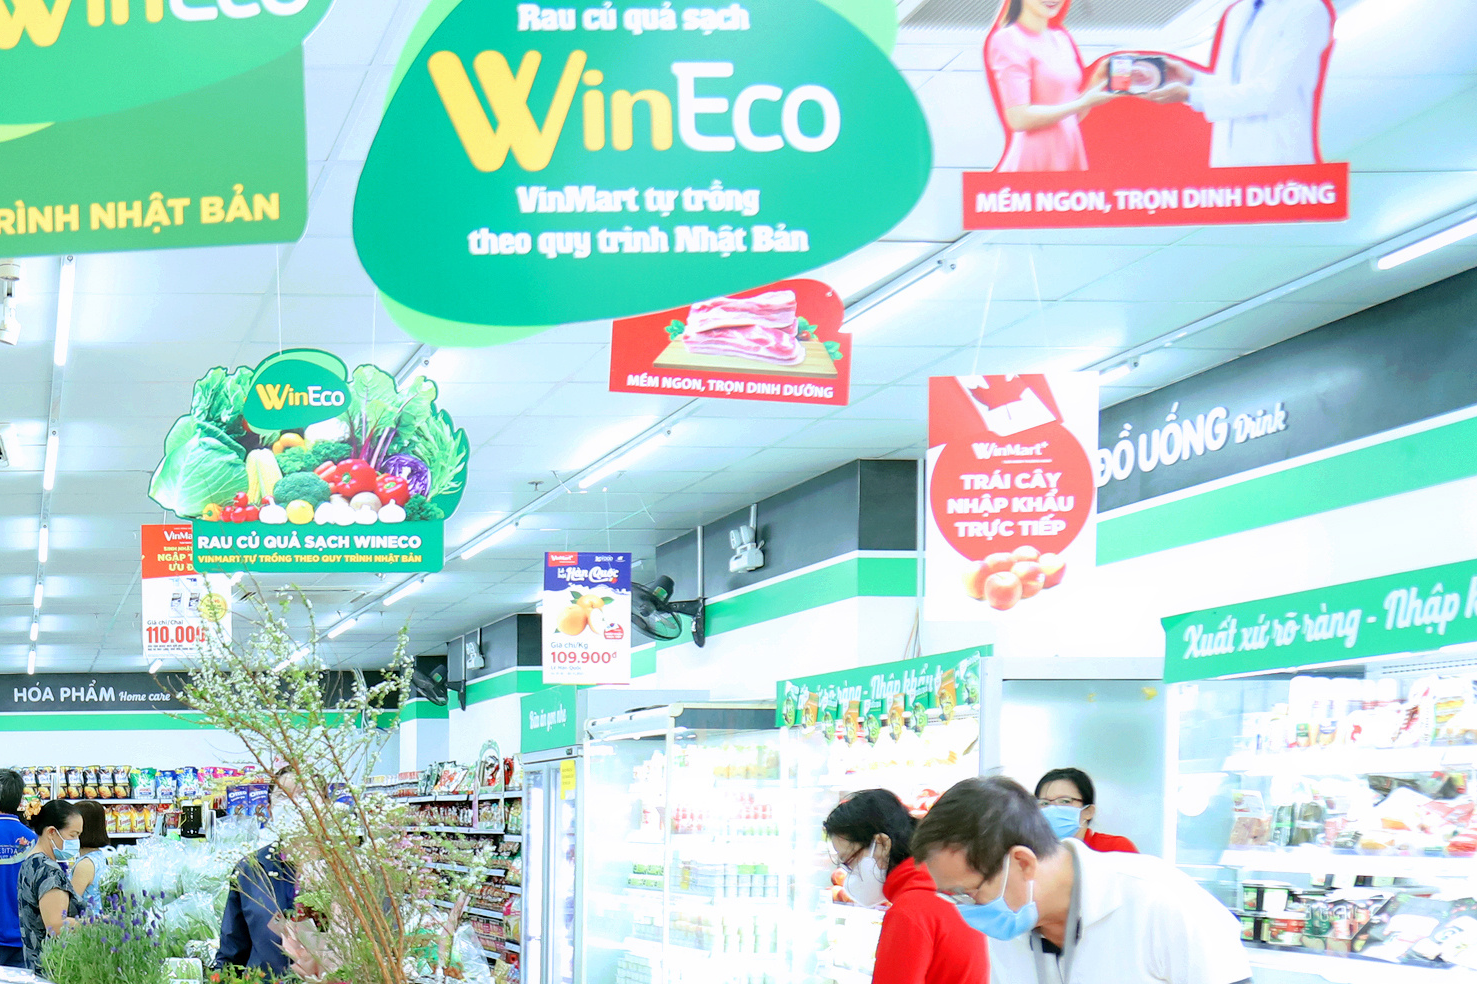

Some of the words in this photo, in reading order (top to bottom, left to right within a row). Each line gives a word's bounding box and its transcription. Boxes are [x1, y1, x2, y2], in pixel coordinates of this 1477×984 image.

[517, 4, 577, 32] Rau
[582, 2, 617, 30] củ
[624, 2, 677, 35] quả
[682, 3, 750, 36] sạch
[427, 49, 841, 172] WinEco
[89, 191, 191, 234] NHẬT
[199, 183, 281, 225] BẢN
[516, 184, 640, 214] VinMart
[643, 187, 680, 218] tự
[681, 179, 761, 217] trồng
[1035, 191, 1113, 214] NGON,
[1112, 188, 1181, 215] TRỌN
[1182, 188, 1244, 211] DINH
[1246, 179, 1337, 208] DƯỠNG
[467, 227, 533, 256] theo
[537, 231, 592, 260] quy
[596, 225, 669, 253] trình
[674, 224, 748, 258] Nhật
[751, 222, 810, 253] Bản
[255, 383, 346, 411] WinEco
[661, 377, 706, 393] NGON,
[707, 378, 744, 396] TRỌN
[746, 381, 779, 395] DINH
[1137, 401, 1230, 473] UỐNG
[1234, 402, 1288, 444] Drink
[959, 469, 1011, 490] TRÁI
[1014, 468, 1063, 489] CÂY
[946, 494, 1008, 518] NHẬP
[1010, 489, 1075, 513] KHẨU
[164, 530, 193, 541] VinMa
[197, 536, 233, 549] RAU
[236, 530, 260, 549] CỦ
[263, 530, 301, 549] QUẢ
[304, 535, 350, 552] SẠCH
[353, 535, 422, 549] WINECO
[953, 519, 1015, 541] TRỰC
[1017, 513, 1067, 537] TIẾP
[197, 555, 242, 564] VINMART
[294, 554, 320, 563] THEO
[321, 554, 342, 564] QUY
[344, 553, 373, 563] TRÌNH
[375, 553, 400, 564] NHẬT
[401, 552, 422, 563] BẢN
[1183, 614, 1238, 660] Xuất
[1238, 613, 1271, 652] xứ
[1273, 611, 1300, 647] rõ
[1302, 603, 1362, 649] ràng
[1383, 583, 1461, 635] Nhập
[13, 681, 55, 703] HÓA
[59, 679, 116, 702] PHẨM
[118, 691, 146, 702] Home
[148, 692, 171, 701] care
